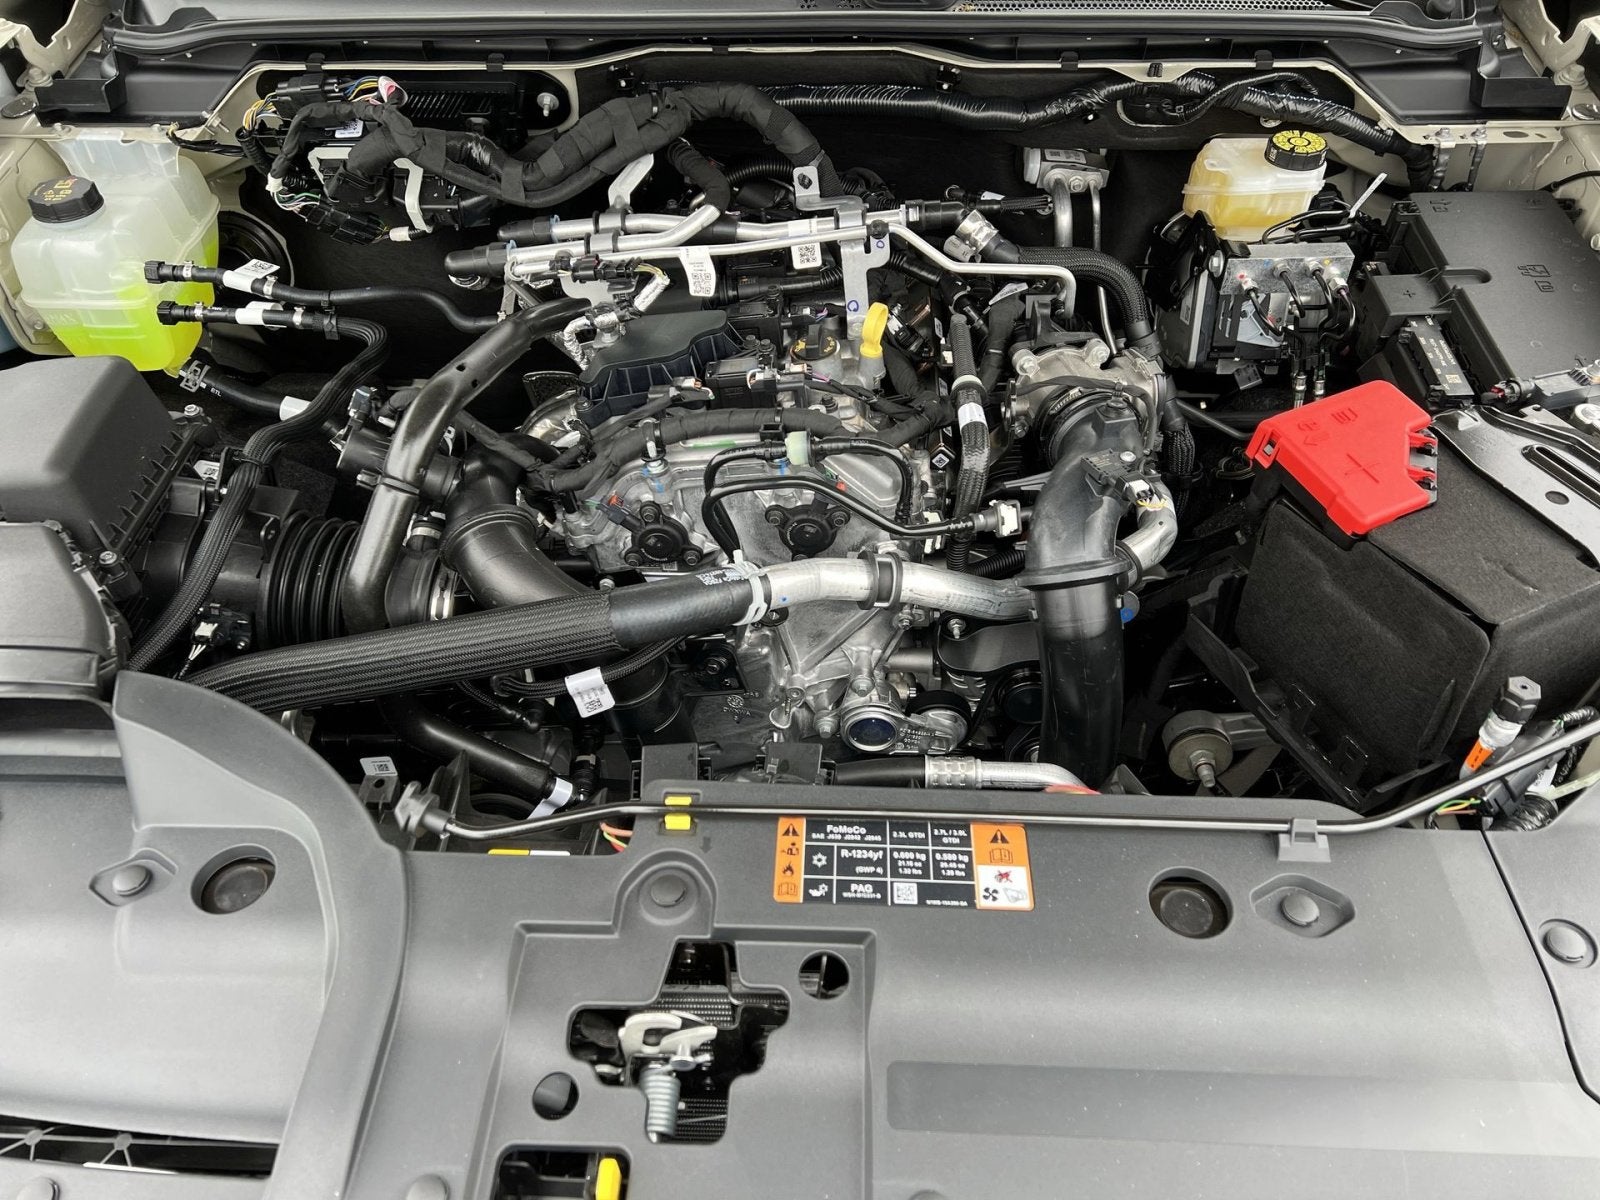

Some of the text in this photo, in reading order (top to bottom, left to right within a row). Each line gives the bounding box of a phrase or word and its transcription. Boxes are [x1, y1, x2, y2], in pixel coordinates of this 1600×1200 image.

[826, 824, 867, 834] FoMoCo
[840, 848, 884, 862] R-1234yf
[915, 852, 927, 861] kg
[958, 854, 969, 863] kg
[850, 883, 873, 893] PAG
